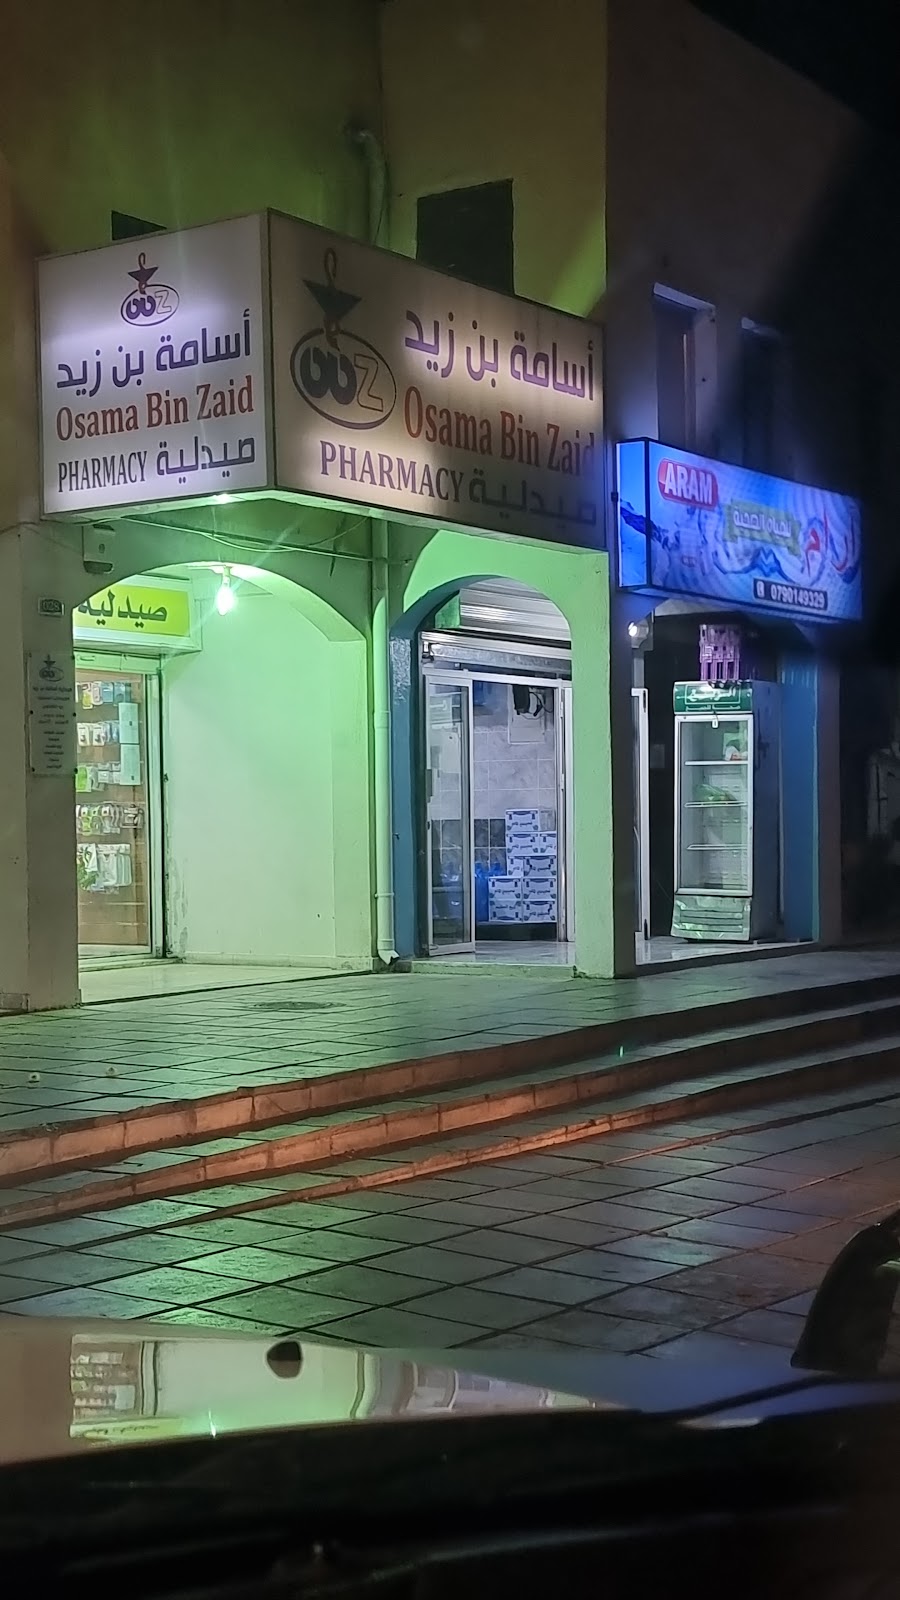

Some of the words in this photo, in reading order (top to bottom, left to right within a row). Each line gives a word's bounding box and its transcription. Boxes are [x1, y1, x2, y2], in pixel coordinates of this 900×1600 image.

[112, 346, 144, 388] بن
[156, 308, 251, 372] أسامة
[404, 310, 455, 378] زيد
[466, 320, 499, 388] بن
[510, 330, 595, 401] أسامة
[57, 349, 101, 397] زيد
[56, 405, 139, 441] Osama
[146, 390, 189, 429] Bin
[196, 375, 254, 421] Zaid
[404, 386, 493, 456] Osama
[500, 411, 540, 468] Bin
[546, 423, 596, 479] Zaid
[58, 451, 148, 493] PHARMACY
[156, 436, 255, 484] صيدلية
[320, 441, 464, 502] PHARMACY
[664, 462, 713, 505] ARAM
[468, 468, 597, 529] صيدلية
